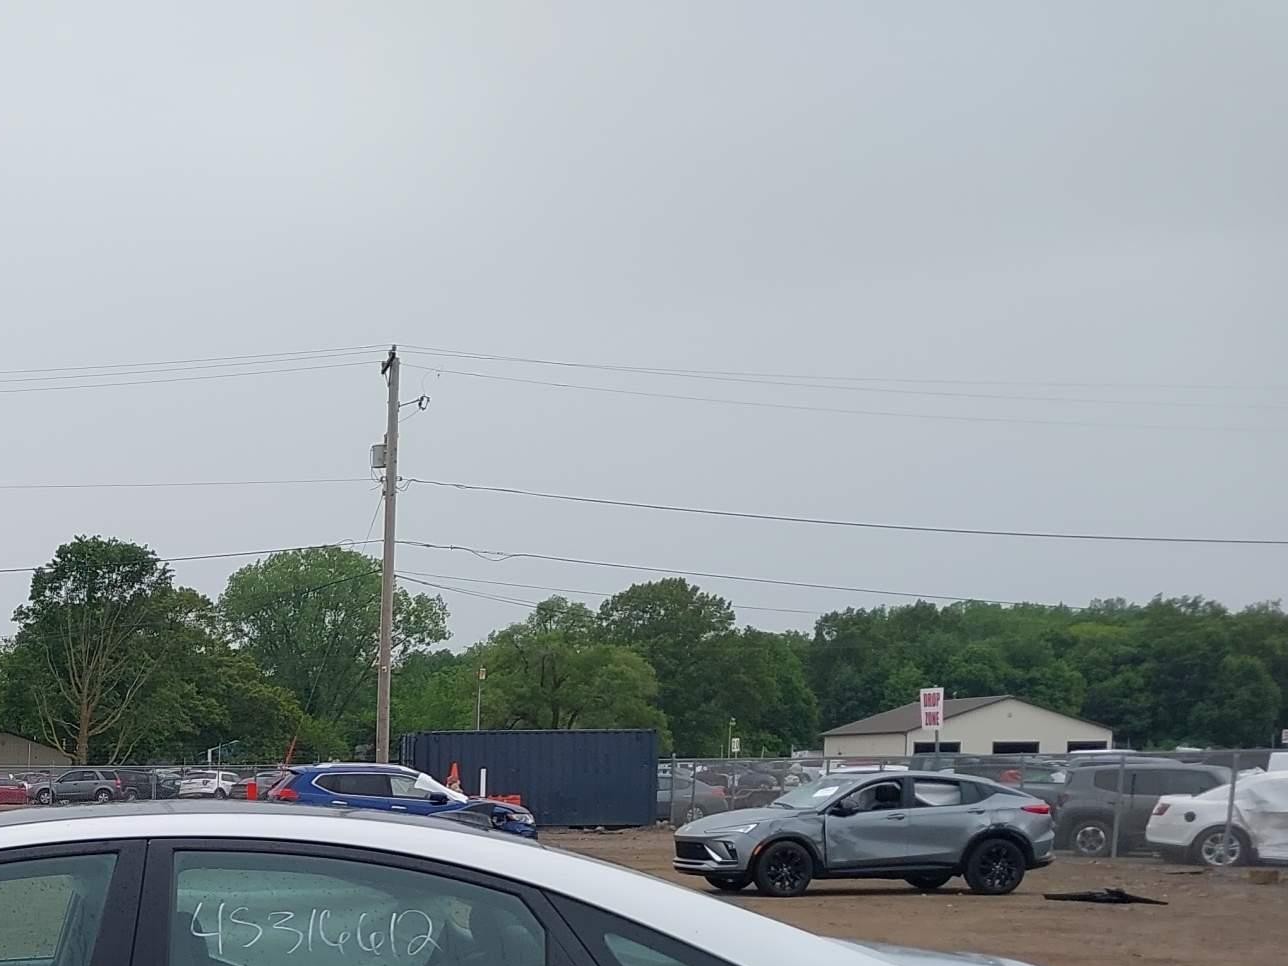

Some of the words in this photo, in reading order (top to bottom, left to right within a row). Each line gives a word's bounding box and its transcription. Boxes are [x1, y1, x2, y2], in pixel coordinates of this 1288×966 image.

[923, 692, 941, 707] DROP
[925, 711, 940, 726] ZONE
[190, 902, 443, 956] 45316612
